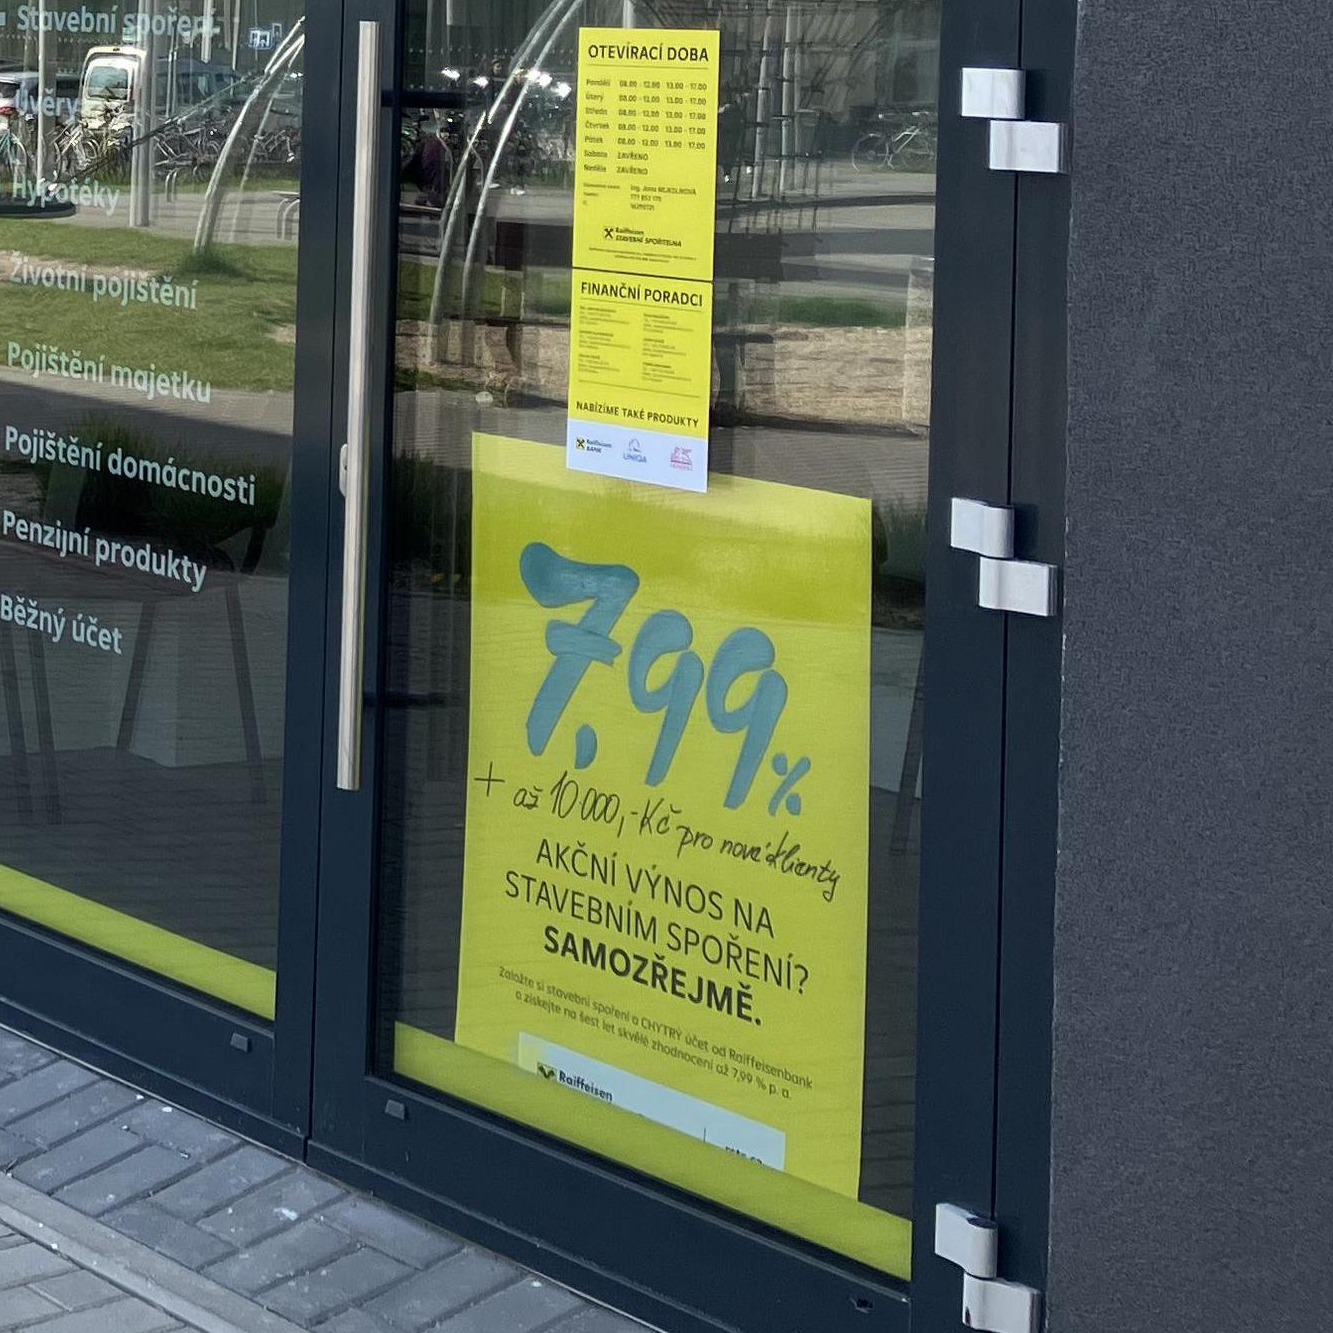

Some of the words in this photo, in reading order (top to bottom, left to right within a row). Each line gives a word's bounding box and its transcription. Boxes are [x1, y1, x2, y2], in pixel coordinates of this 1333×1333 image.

[17, 5, 118, 34] Stavební
[588, 42, 663, 61] OTEVÍRACÍ
[667, 47, 709, 61] DOBA
[13, 177, 120, 216] Hypotéky
[10, 250, 87, 293] Životní
[93, 269, 199, 310] pojištění
[581, 282, 641, 300] FINANČNÍ
[644, 289, 702, 307] PORADCI
[6, 341, 105, 383] Pojištění
[111, 362, 212, 404] majetku
[576, 401, 619, 416] NABÍZÍME
[623, 408, 645, 420] TAKÉ
[647, 412, 699, 427] PRODUKTY
[5, 425, 102, 471] Pojištění
[108, 448, 256, 506] domácnosti
[2, 509, 90, 558] Penzijní
[95, 537, 207, 593] produkty
[0, 594, 67, 643] Běžný
[72, 613, 123, 655] účet
[474, 761, 505, 797] +
[513, 786, 543, 810] až
[676, 825, 714, 859] pro
[719, 836, 771, 863] nové
[765, 830, 841, 903] klienty
[536, 838, 617, 887] AKČNÍ
[626, 864, 724, 921] VÝNOS
[734, 898, 775, 938] NA
[505, 870, 657, 945] STAVEBNÍM
[667, 922, 809, 995] SPOŘENÍ?
[544, 925, 762, 1026] SAMOZŘEJMĚ.
[499, 966, 534, 988] Založte
[536, 980, 545, 991] si
[546, 985, 591, 1007] stavební
[593, 999, 631, 1022] spoření
[631, 1016, 639, 1026] a
[641, 1017, 683, 1042] CHYTRÝ
[685, 1032, 709, 1052] účet
[711, 1044, 727, 1058] od
[729, 1048, 813, 1089] Raiffeisenbank
[515, 991, 522, 1000] a
[524, 991, 562, 1014] získejte
[564, 1006, 577, 1020] na
[579, 1009, 600, 1027] šest
[602, 1020, 616, 1035] let
[618, 1025, 649, 1047] skvělé
[651, 1038, 714, 1072] zhodnocení
[715, 1062, 729, 1077] až
[731, 1067, 754, 1084] 7,99
[756, 1075, 767, 1091] %
[559, 1070, 613, 1102] Raiffeisen
